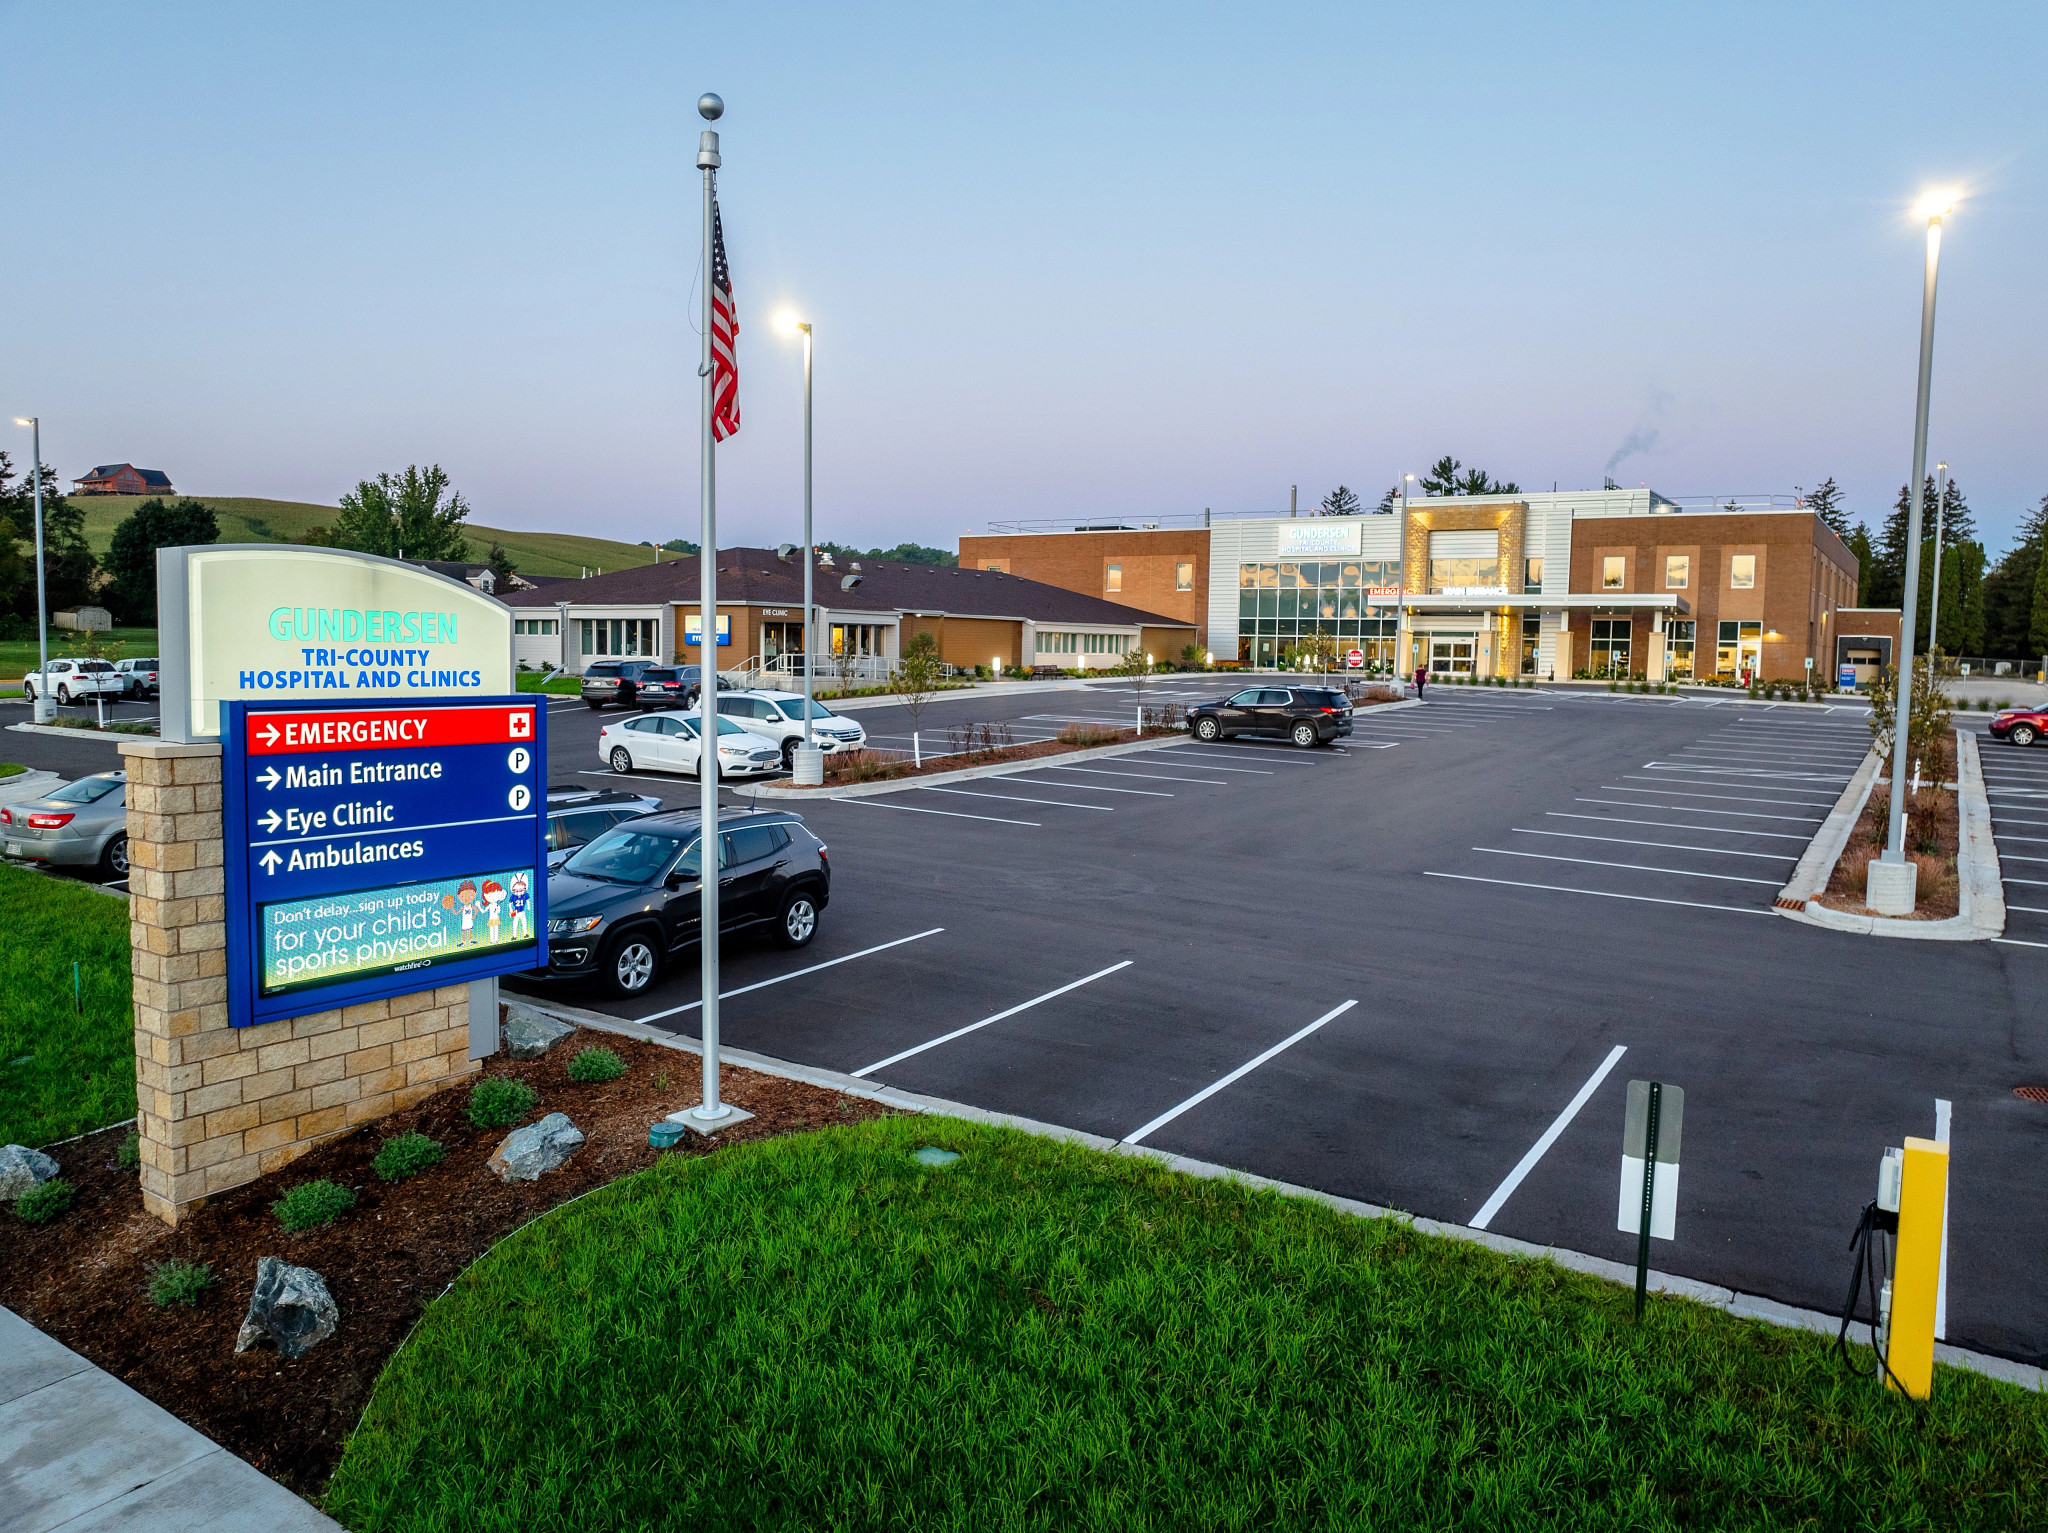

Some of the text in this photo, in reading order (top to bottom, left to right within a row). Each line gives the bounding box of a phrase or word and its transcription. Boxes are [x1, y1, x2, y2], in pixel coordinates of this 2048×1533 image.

[1289, 527, 1349, 539] GUNDERSEN
[268, 606, 458, 644] GUNDERSEN
[301, 648, 430, 667] TRI-COUNTY
[239, 670, 481, 689] HOSPITAL AND CLINICS
[285, 718, 428, 746] EMERGENCY
[515, 752, 525, 769] P
[285, 761, 442, 789] Main Entrance
[515, 789, 525, 806] P
[286, 800, 394, 836] Eye Clinic
[287, 839, 424, 872] Ambulances
[274, 907, 311, 925] Don't
[387, 896, 403, 909] up
[406, 890, 440, 905] today
[274, 906, 441, 952] for your child's
[275, 926, 447, 979] sports physical
